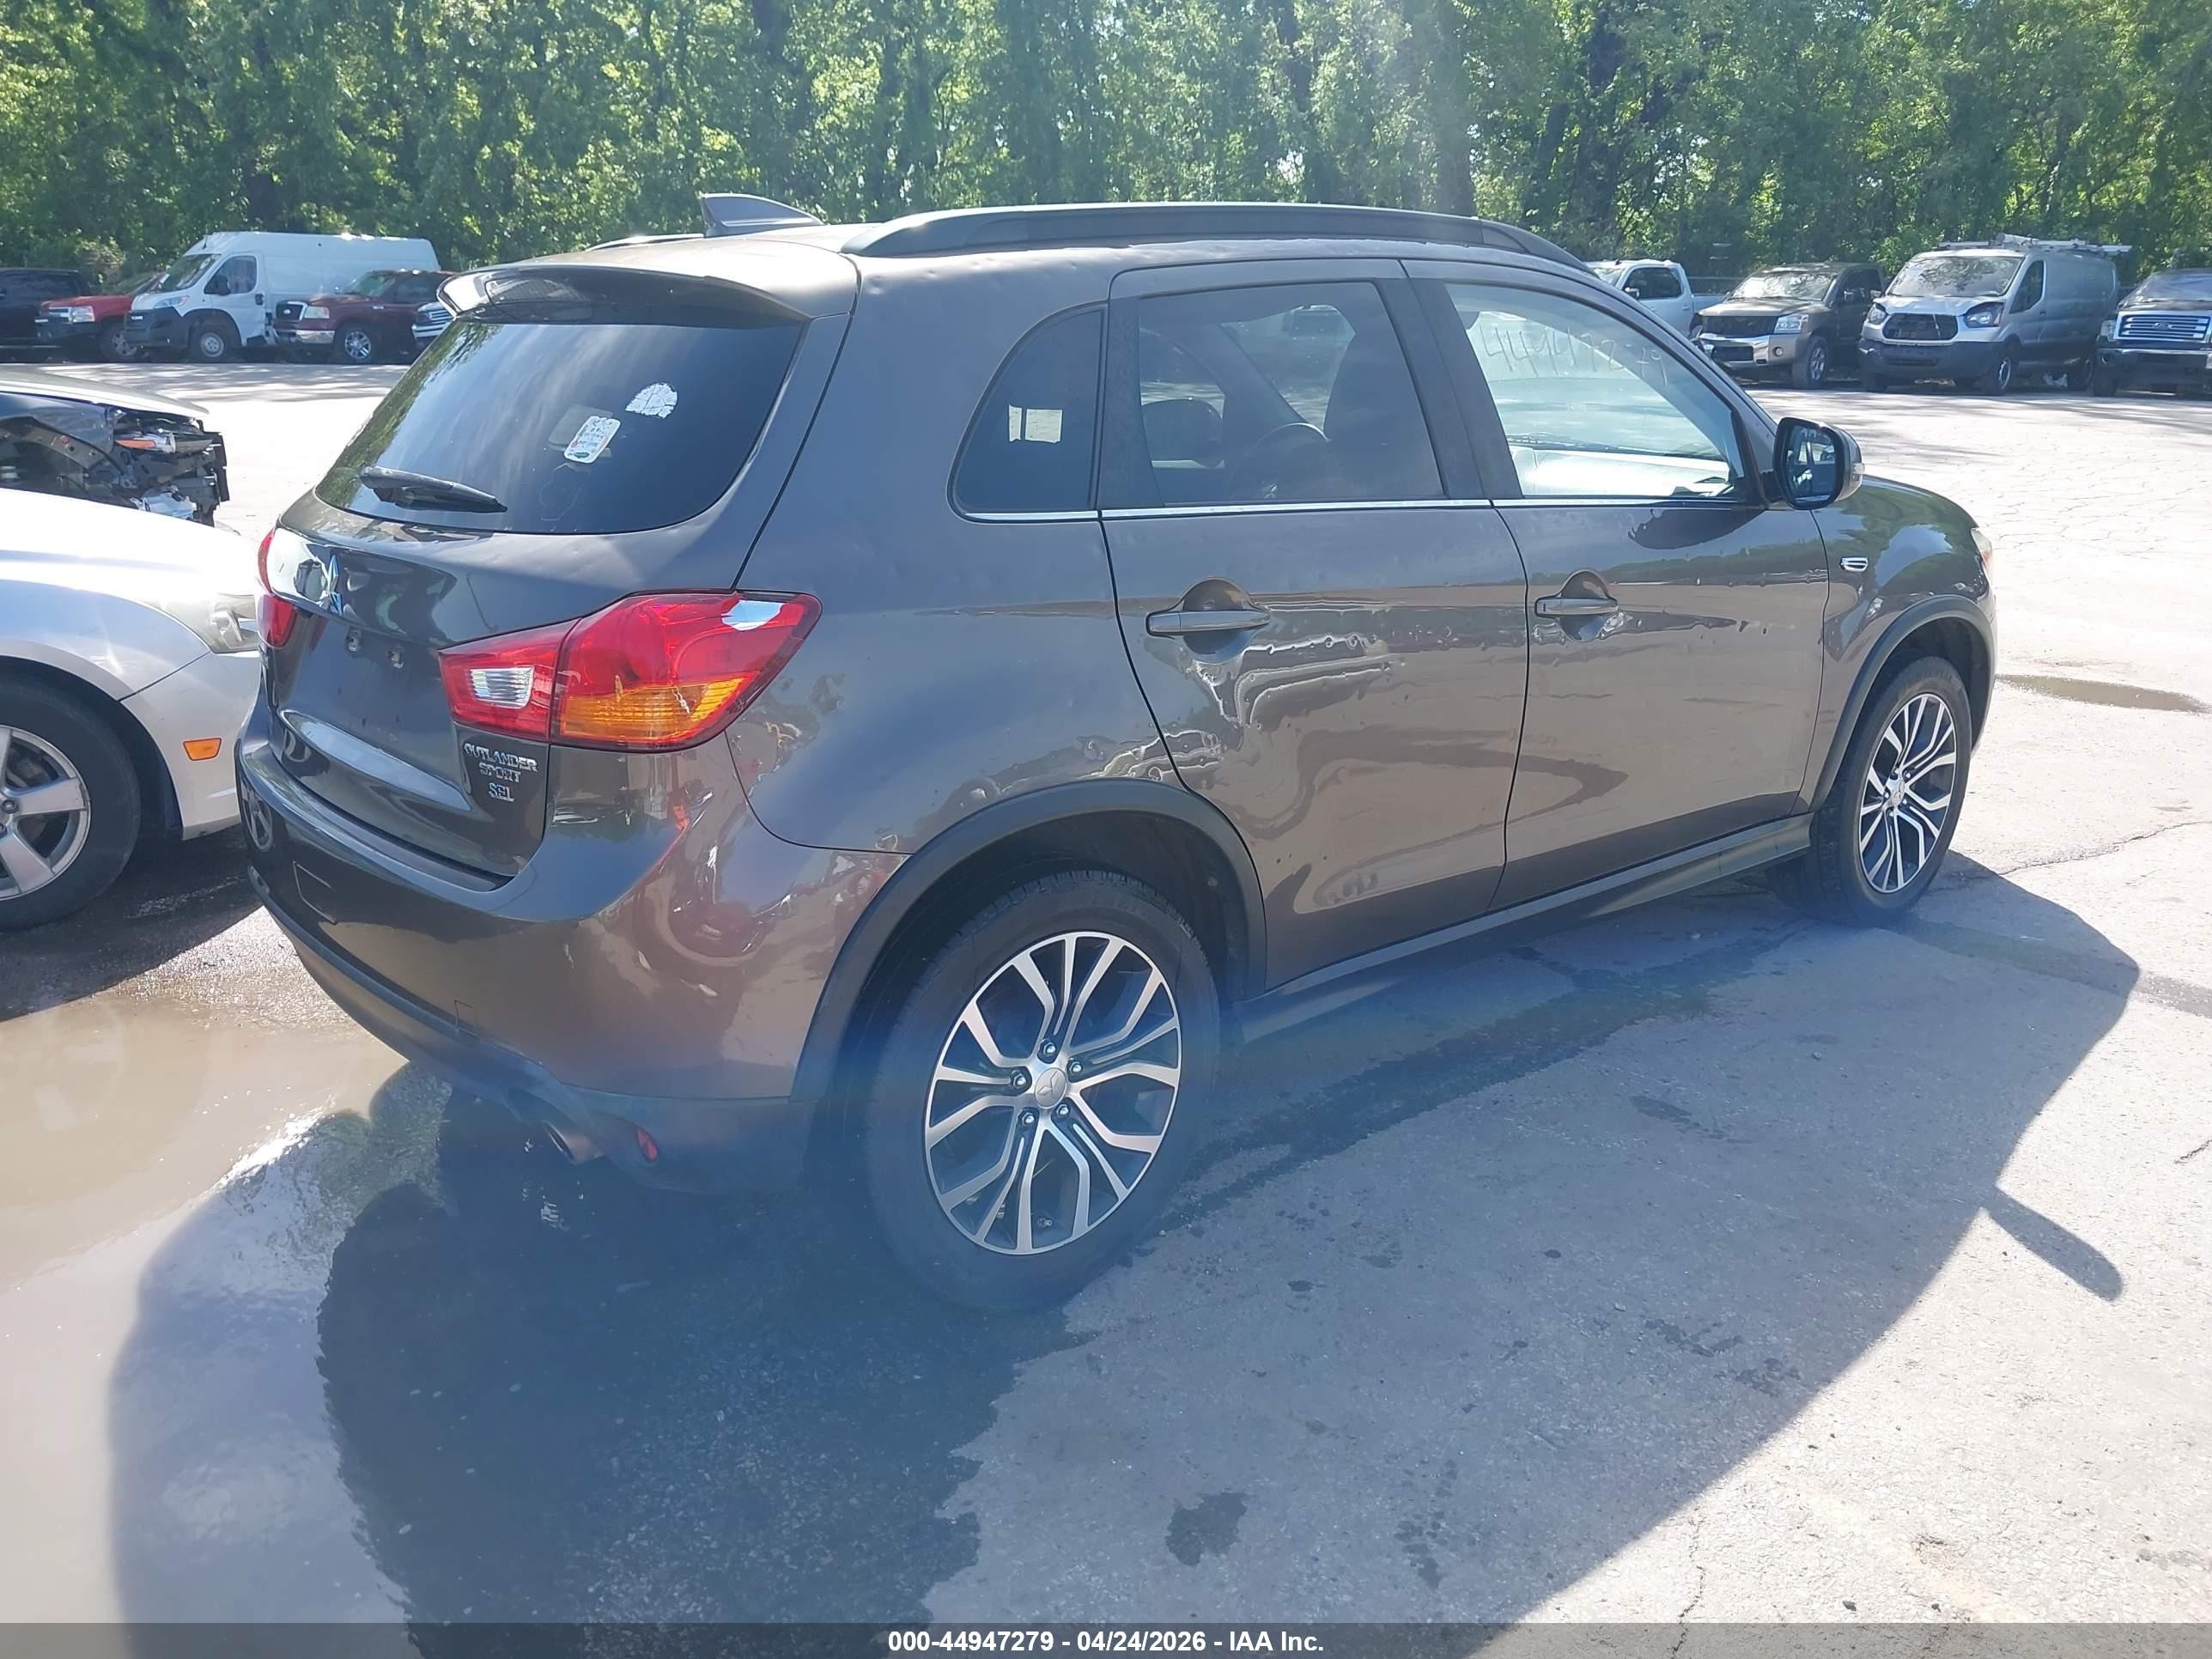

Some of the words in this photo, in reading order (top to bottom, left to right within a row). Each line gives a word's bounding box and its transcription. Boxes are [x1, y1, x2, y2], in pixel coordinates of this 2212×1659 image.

[463, 742, 539, 773] OUTLANDER
[478, 761, 522, 783] SPORT
[488, 781, 516, 803] SEL
